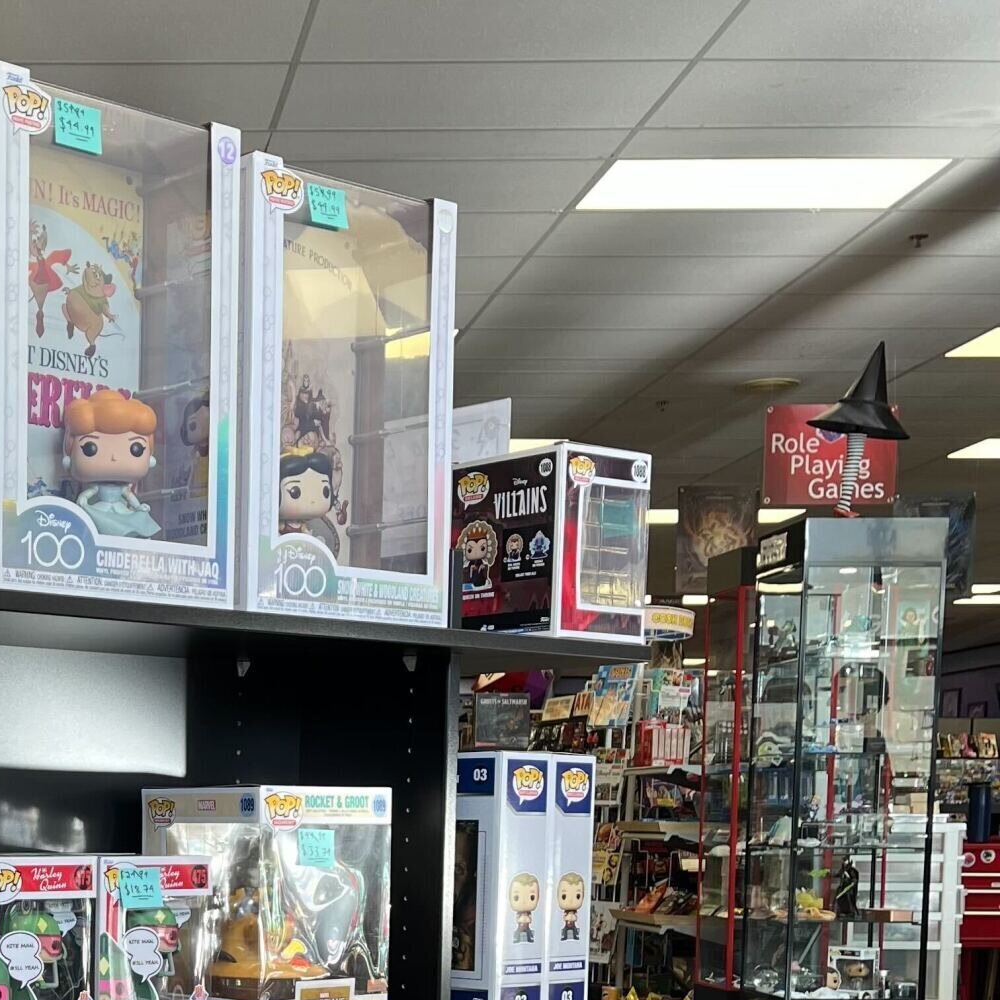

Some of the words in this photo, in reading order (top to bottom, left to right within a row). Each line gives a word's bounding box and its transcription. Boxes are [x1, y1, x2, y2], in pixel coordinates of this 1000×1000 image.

[3, 85, 49, 120] POP!
[219, 138, 236, 162] 12
[262, 169, 302, 199] POP!
[58, 184, 80, 210] It's
[82, 189, 141, 223] MAGIC!
[39, 347, 110, 379] DISNEY'S
[771, 432, 820, 454] Role
[790, 454, 871, 479] Playig
[458, 472, 488, 494] POP!
[493, 485, 548, 520] VILLAINS
[34, 509, 72, 534] Disney
[20, 530, 86, 570] 100
[96, 550, 165, 574] CINDERELLA
[168, 557, 197, 577] WITH
[199, 559, 220, 580] JAQ
[274, 563, 327, 598] 100
[473, 768, 488, 782] 03
[512, 765, 543, 789] POP!
[561, 768, 588, 792] POP!
[264, 793, 302, 818] POP!
[305, 795, 335, 809] ROCKET
[344, 796, 370, 809] GROOT
[31, 866, 63, 881] Harley
[39, 877, 67, 891] Quinn
